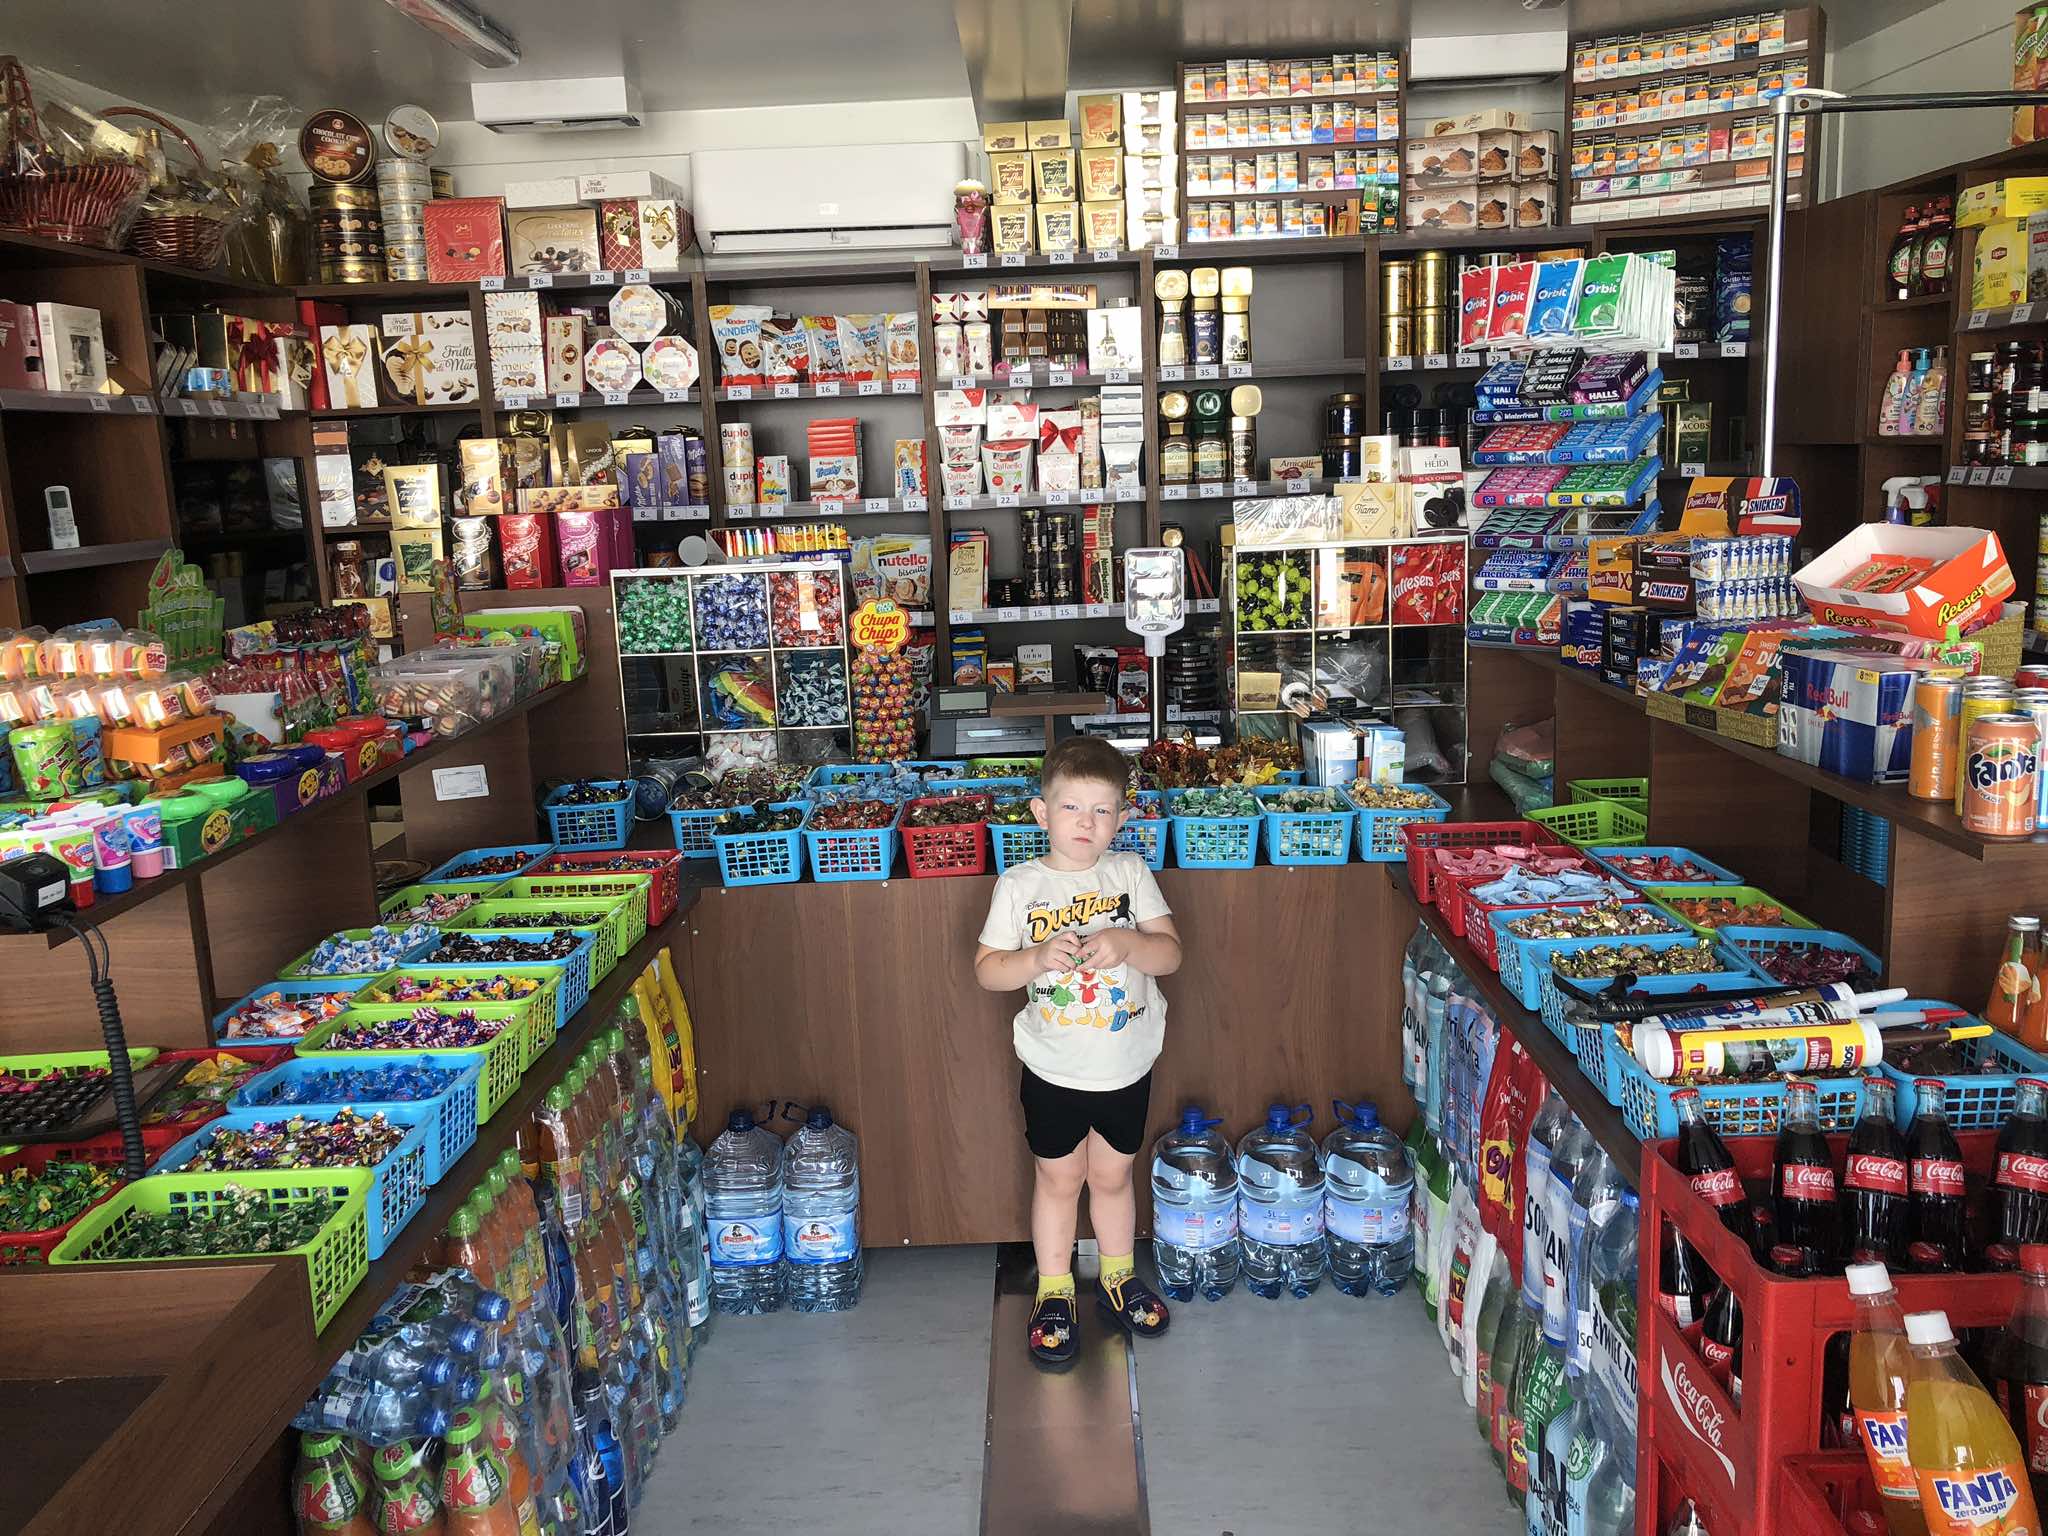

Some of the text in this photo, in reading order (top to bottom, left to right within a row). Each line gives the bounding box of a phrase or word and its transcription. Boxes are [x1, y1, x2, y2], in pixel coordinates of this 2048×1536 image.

[1159, 248, 1169, 256] 20
[1006, 256, 1016, 264] 20
[1054, 253, 1064, 261] 20
[594, 274, 605, 282] 20
[630, 272, 640, 280] 20
[533, 277, 544, 285] 26
[1584, 282, 1617, 296] Orbit
[1538, 287, 1567, 300] Orbit
[1497, 291, 1525, 306] Orbit
[1464, 297, 1488, 314] Orbit
[1679, 348, 1690, 356] 80
[1726, 346, 1736, 354] 65
[1393, 360, 1403, 368] 25
[1428, 358, 1439, 366] 45
[1460, 356, 1471, 364] 22
[1547, 356, 1573, 364] HALLS
[1233, 367, 1242, 375] 32
[1630, 365, 1647, 385] HALLS
[1110, 372, 1120, 380] 32
[1539, 373, 1565, 381] HALLS
[957, 379, 967, 387] 19
[732, 389, 742, 397] 25
[779, 387, 789, 395] 28
[1588, 390, 1619, 400] HALLS
[609, 394, 619, 402] 22
[1493, 397, 1521, 405] HALLS
[509, 399, 519, 407] 18
[722, 428, 749, 439] duplo
[992, 462, 1023, 471] Raffaello
[1424, 459, 1449, 468] HEIDI
[1686, 467, 1697, 475] 28
[1204, 487, 1214, 495] 35
[1238, 485, 1248, 493] 36
[1000, 496, 1010, 504] 22
[1051, 494, 1061, 502] 20
[824, 504, 834, 512] 24
[870, 502, 880, 510] 12
[1740, 497, 1785, 516] 2 SNICKERS
[640, 510, 646, 518] 8
[670, 510, 676, 518] 8
[693, 509, 699, 517] 8
[733, 508, 744, 516] 20
[878, 553, 928, 568] nutella
[898, 565, 927, 577] biscuits
[1639, 582, 1686, 599] 2 SNICKERS
[1936, 584, 1985, 627] Reese's
[1060, 608, 1070, 616] 15
[1093, 607, 1098, 615] 6
[954, 614, 964, 622] 16
[1825, 607, 1872, 627] Reese's
[861, 614, 900, 629] Chupa
[859, 627, 899, 641] Chups
[1698, 642, 1729, 657] DUO
[146, 653, 166, 664] BIG
[1807, 682, 1850, 710] Red Bull
[162, 696, 179, 710] BIG
[1855, 1157, 1904, 1180] Coca-Cola
[1690, 1175, 1735, 1193] Coca-Cola
[1673, 1361, 1726, 1448] Coca-Cola
[1864, 1417, 1909, 1448] FAN
[1933, 1472, 2017, 1510] FANTA
[1954, 1501, 2008, 1520] zero sugar
